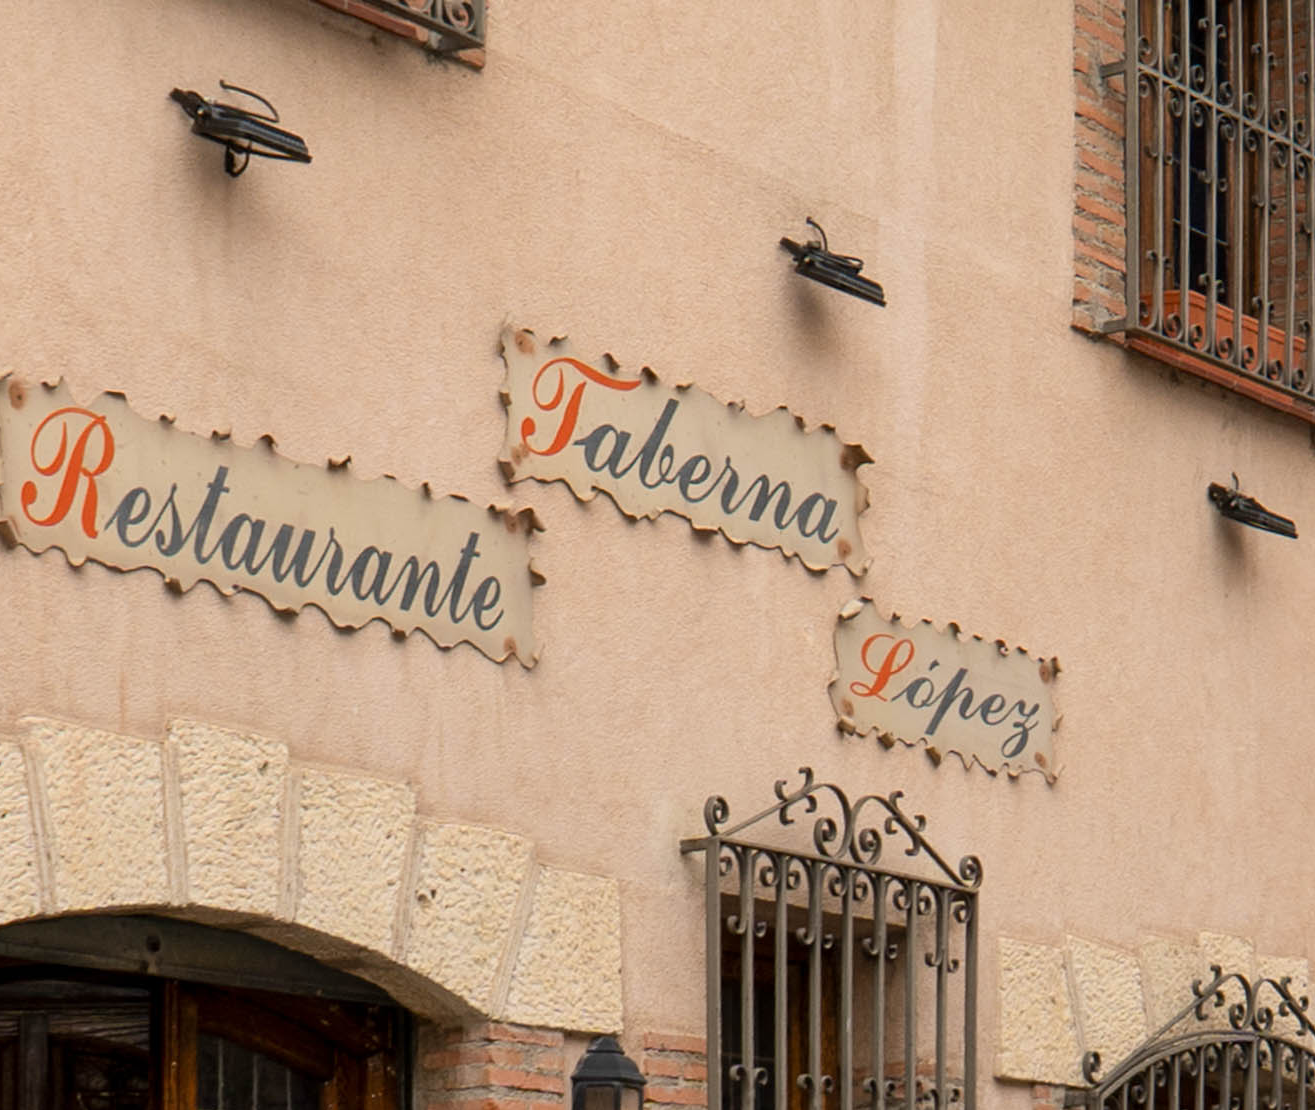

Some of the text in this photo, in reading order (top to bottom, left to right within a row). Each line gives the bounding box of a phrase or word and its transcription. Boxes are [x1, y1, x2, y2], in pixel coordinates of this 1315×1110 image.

[21, 407, 504, 631] Restaurante
[521, 357, 840, 544] Taberna
[850, 634, 1041, 758] López
